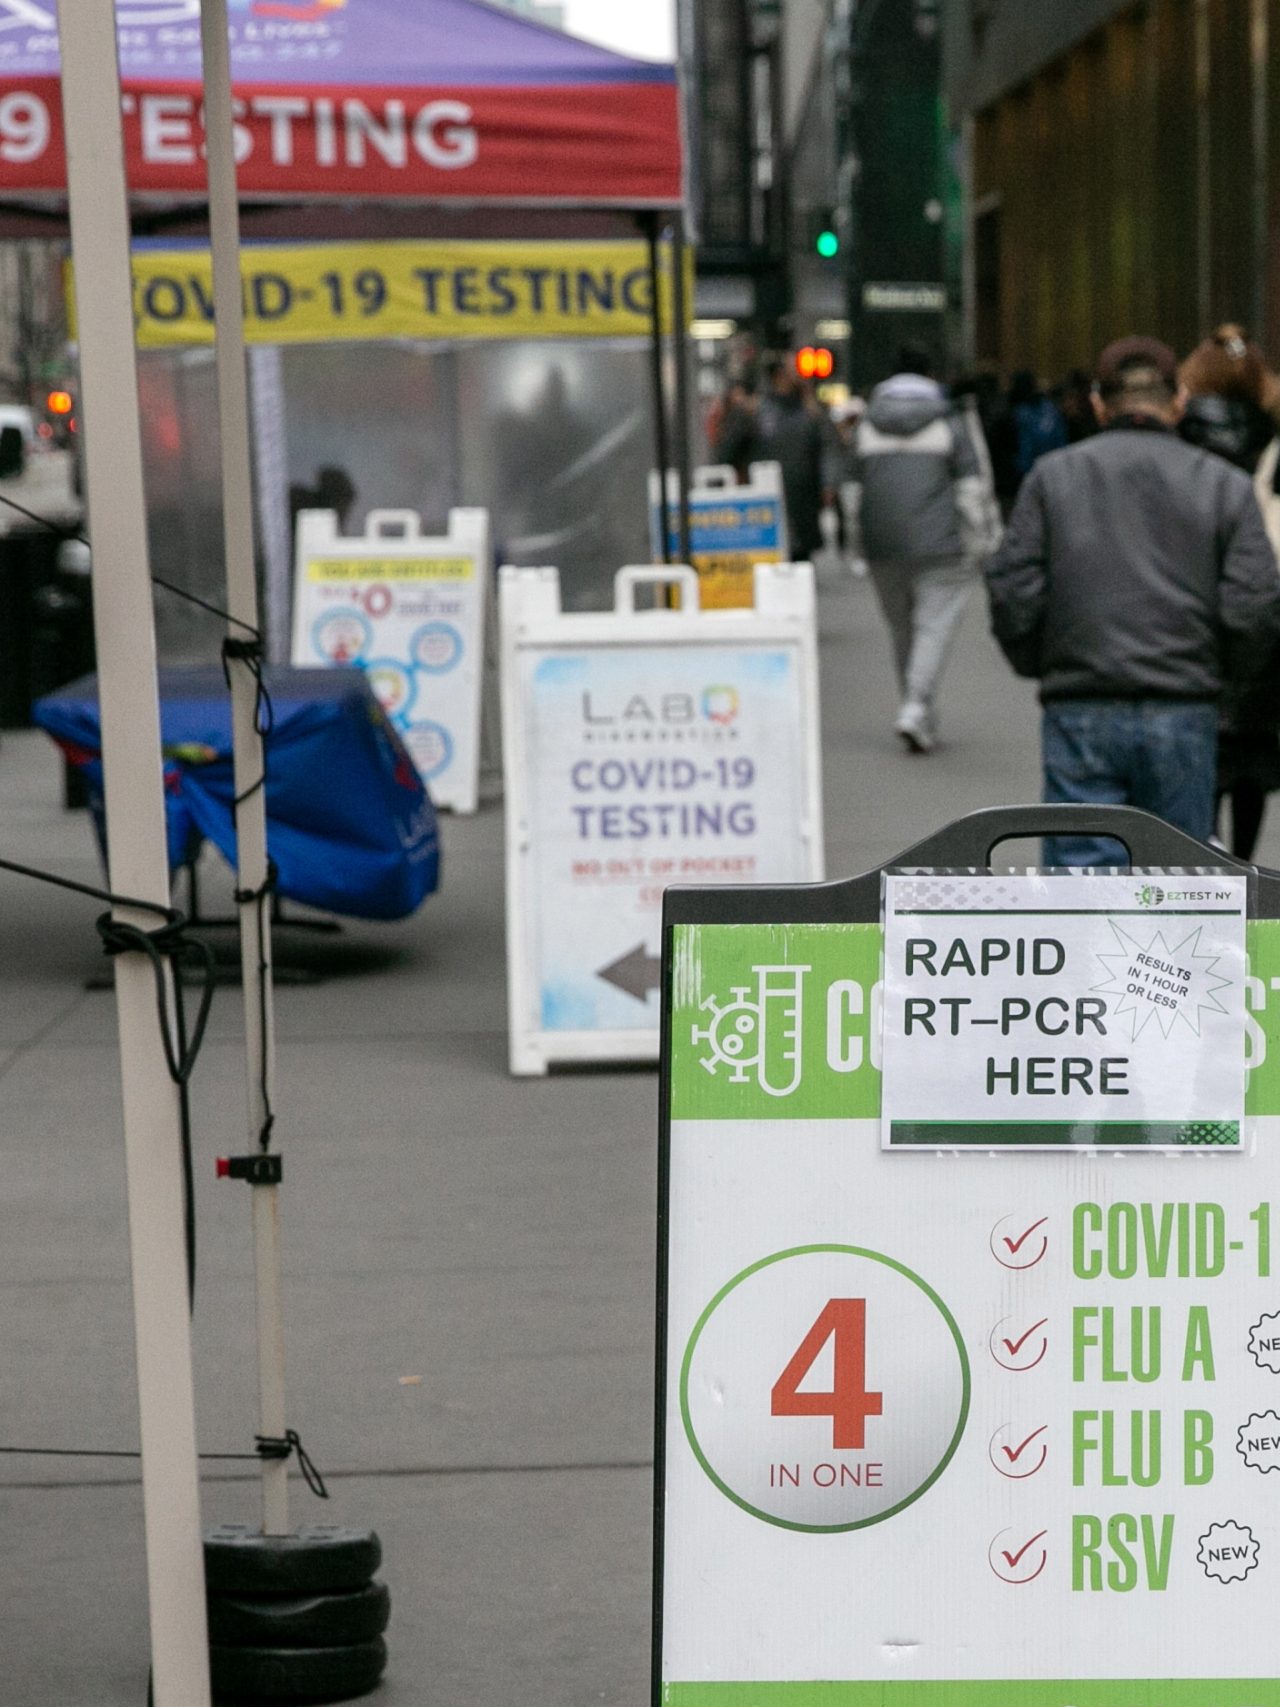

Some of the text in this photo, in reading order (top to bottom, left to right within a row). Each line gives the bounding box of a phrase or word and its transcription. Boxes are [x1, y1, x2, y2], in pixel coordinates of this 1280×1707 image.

[122, 95, 478, 169] ETING
[582, 685, 740, 725] LABQ
[572, 758, 756, 792] COVID-19
[572, 802, 757, 838] TESTING
[1167, 891, 1232, 900] EZTEST NY
[905, 938, 1066, 977] RAPID
[1136, 953, 1192, 981] RESULTS
[1126, 983, 1178, 1010] OR LESS
[1127, 966, 1190, 997] IN 1 HOUR
[986, 1057, 1130, 1095] HERE
[1072, 1306, 1216, 1383] FLU A
[771, 1298, 883, 1450] 4
[1072, 1410, 1214, 1487] FLU B
[770, 1464, 884, 1488] IN ONE
[1072, 1513, 1175, 1592] RSV
[1208, 1546, 1249, 1562] NEW
